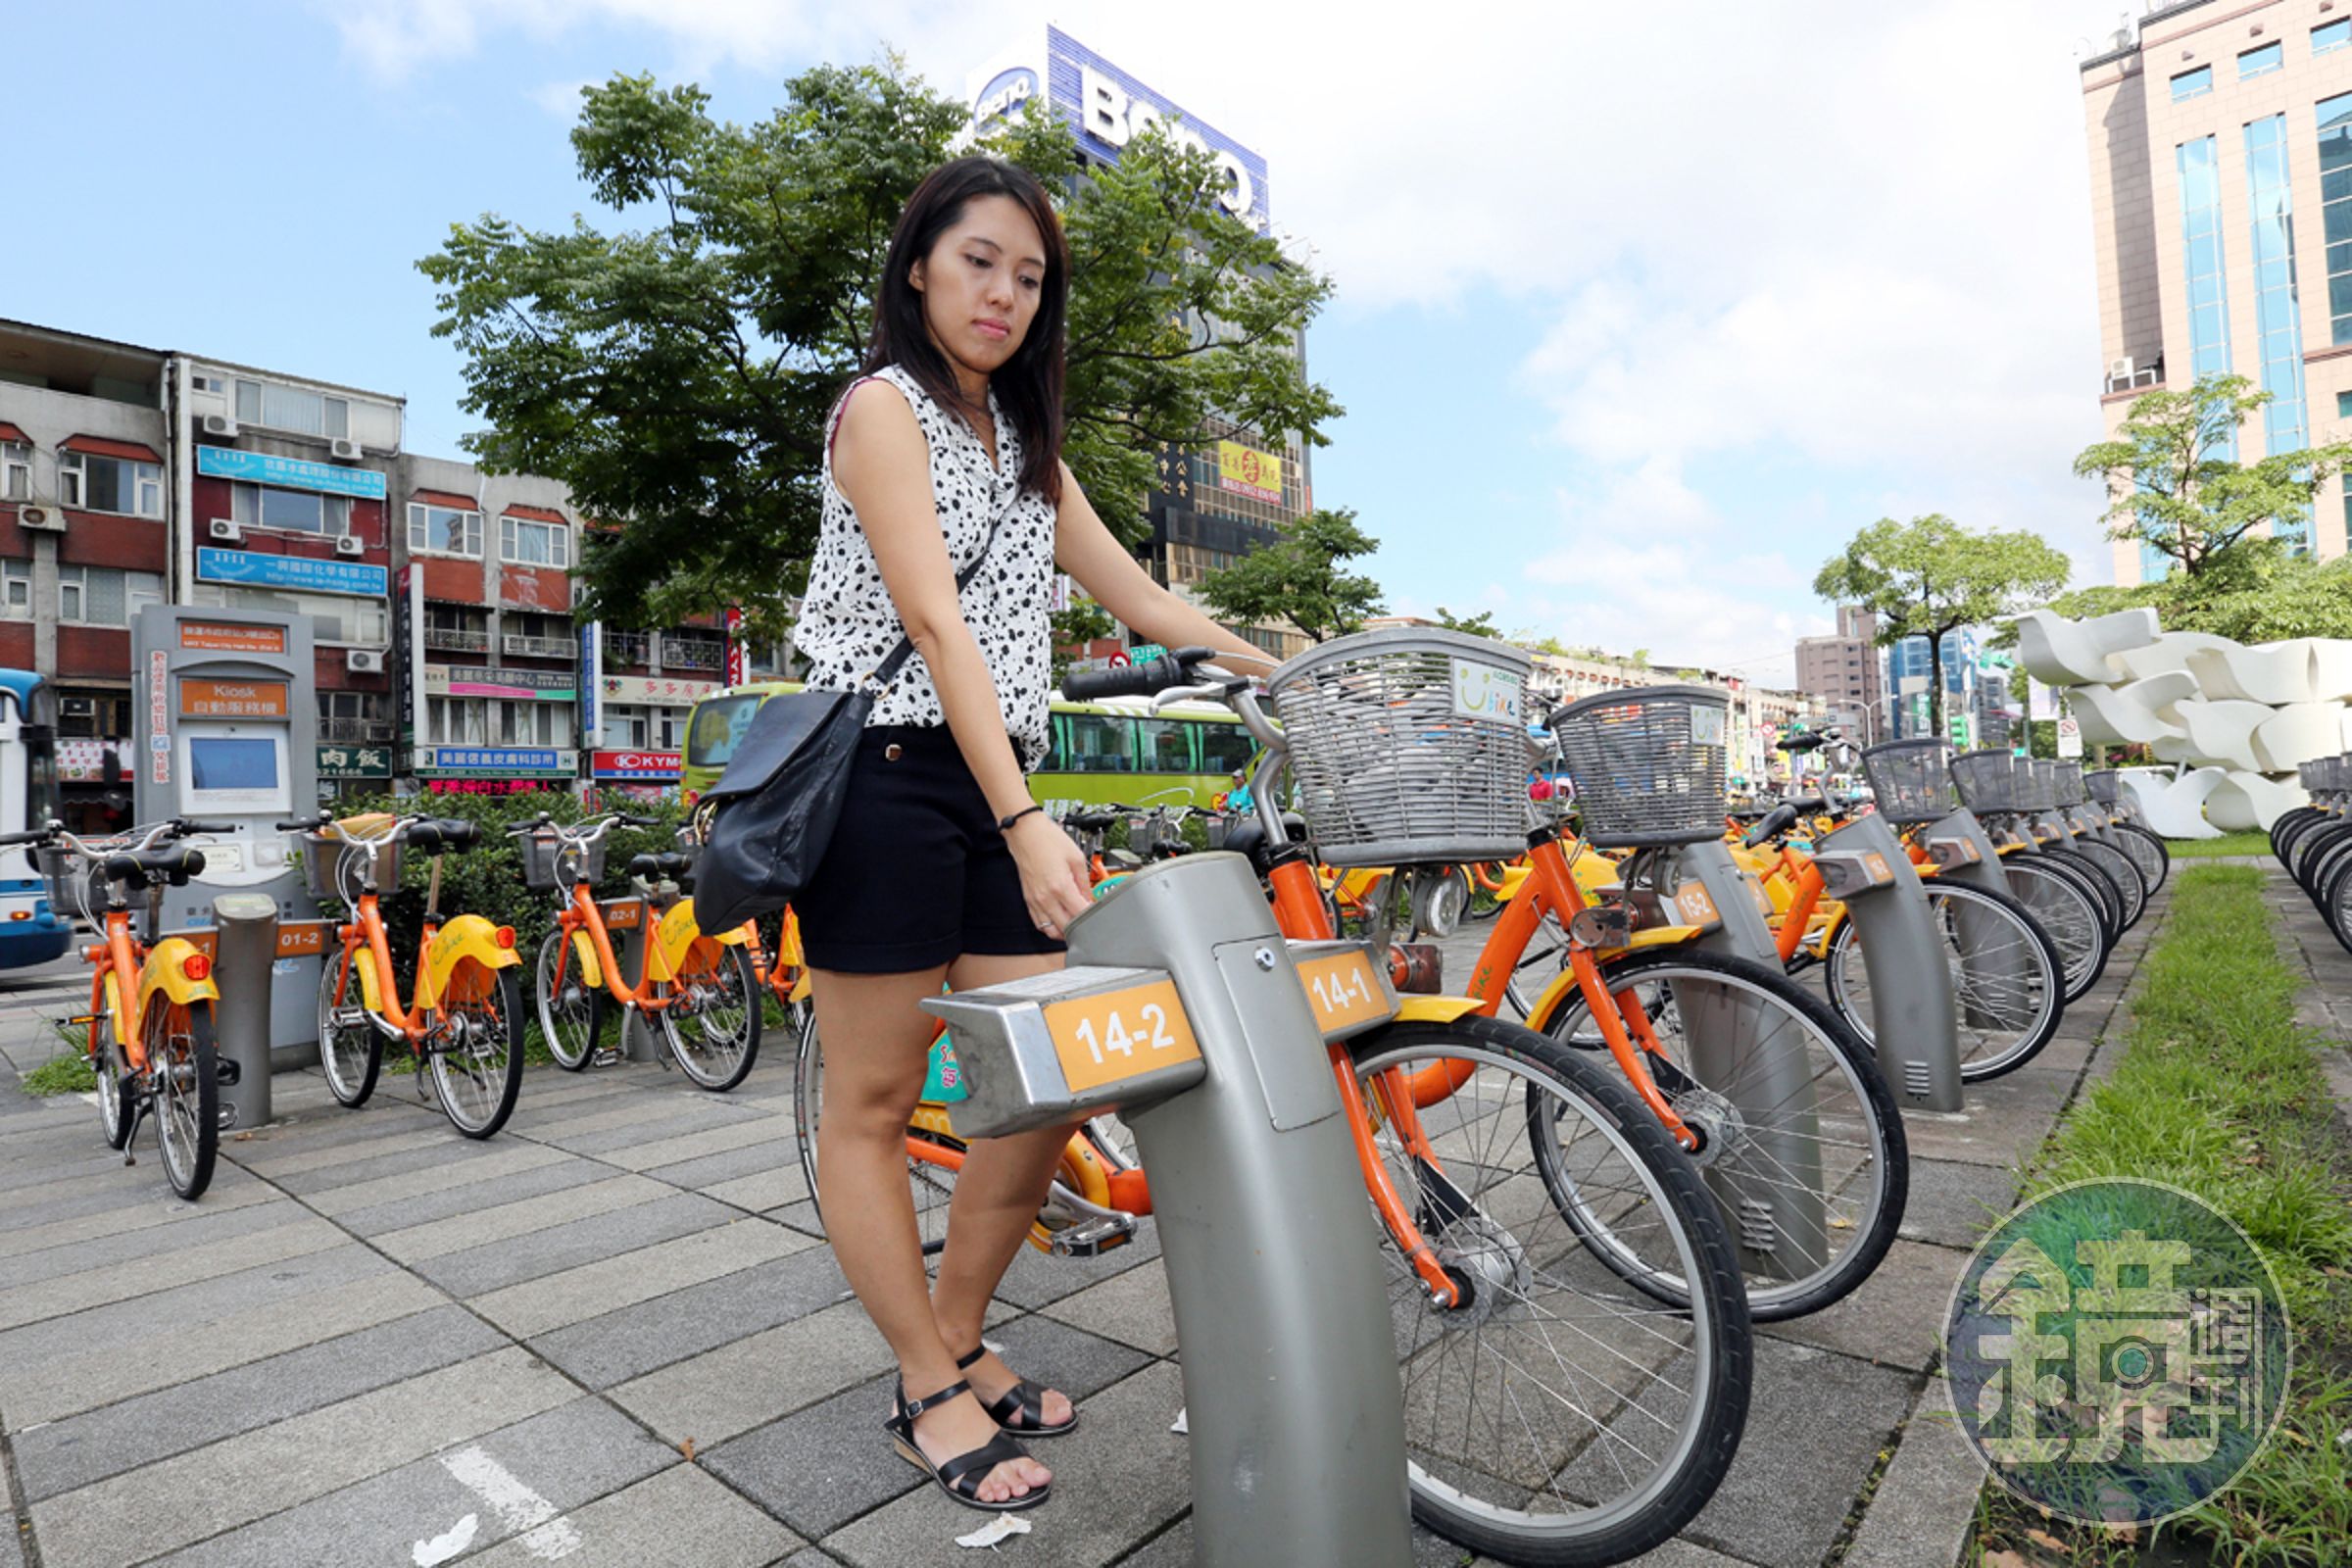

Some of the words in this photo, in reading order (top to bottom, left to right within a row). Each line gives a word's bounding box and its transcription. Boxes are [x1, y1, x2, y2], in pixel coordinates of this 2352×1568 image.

[215, 685, 256, 698] Kiosk
[194, 701, 277, 714] 自動服務機
[643, 756, 682, 768] KYM
[1680, 892, 1711, 918] 15-2
[610, 909, 636, 921] 02-1
[281, 932, 318, 947] 01-2
[1311, 966, 1373, 1013] 14-1
[1074, 1002, 1176, 1065] 14-2
